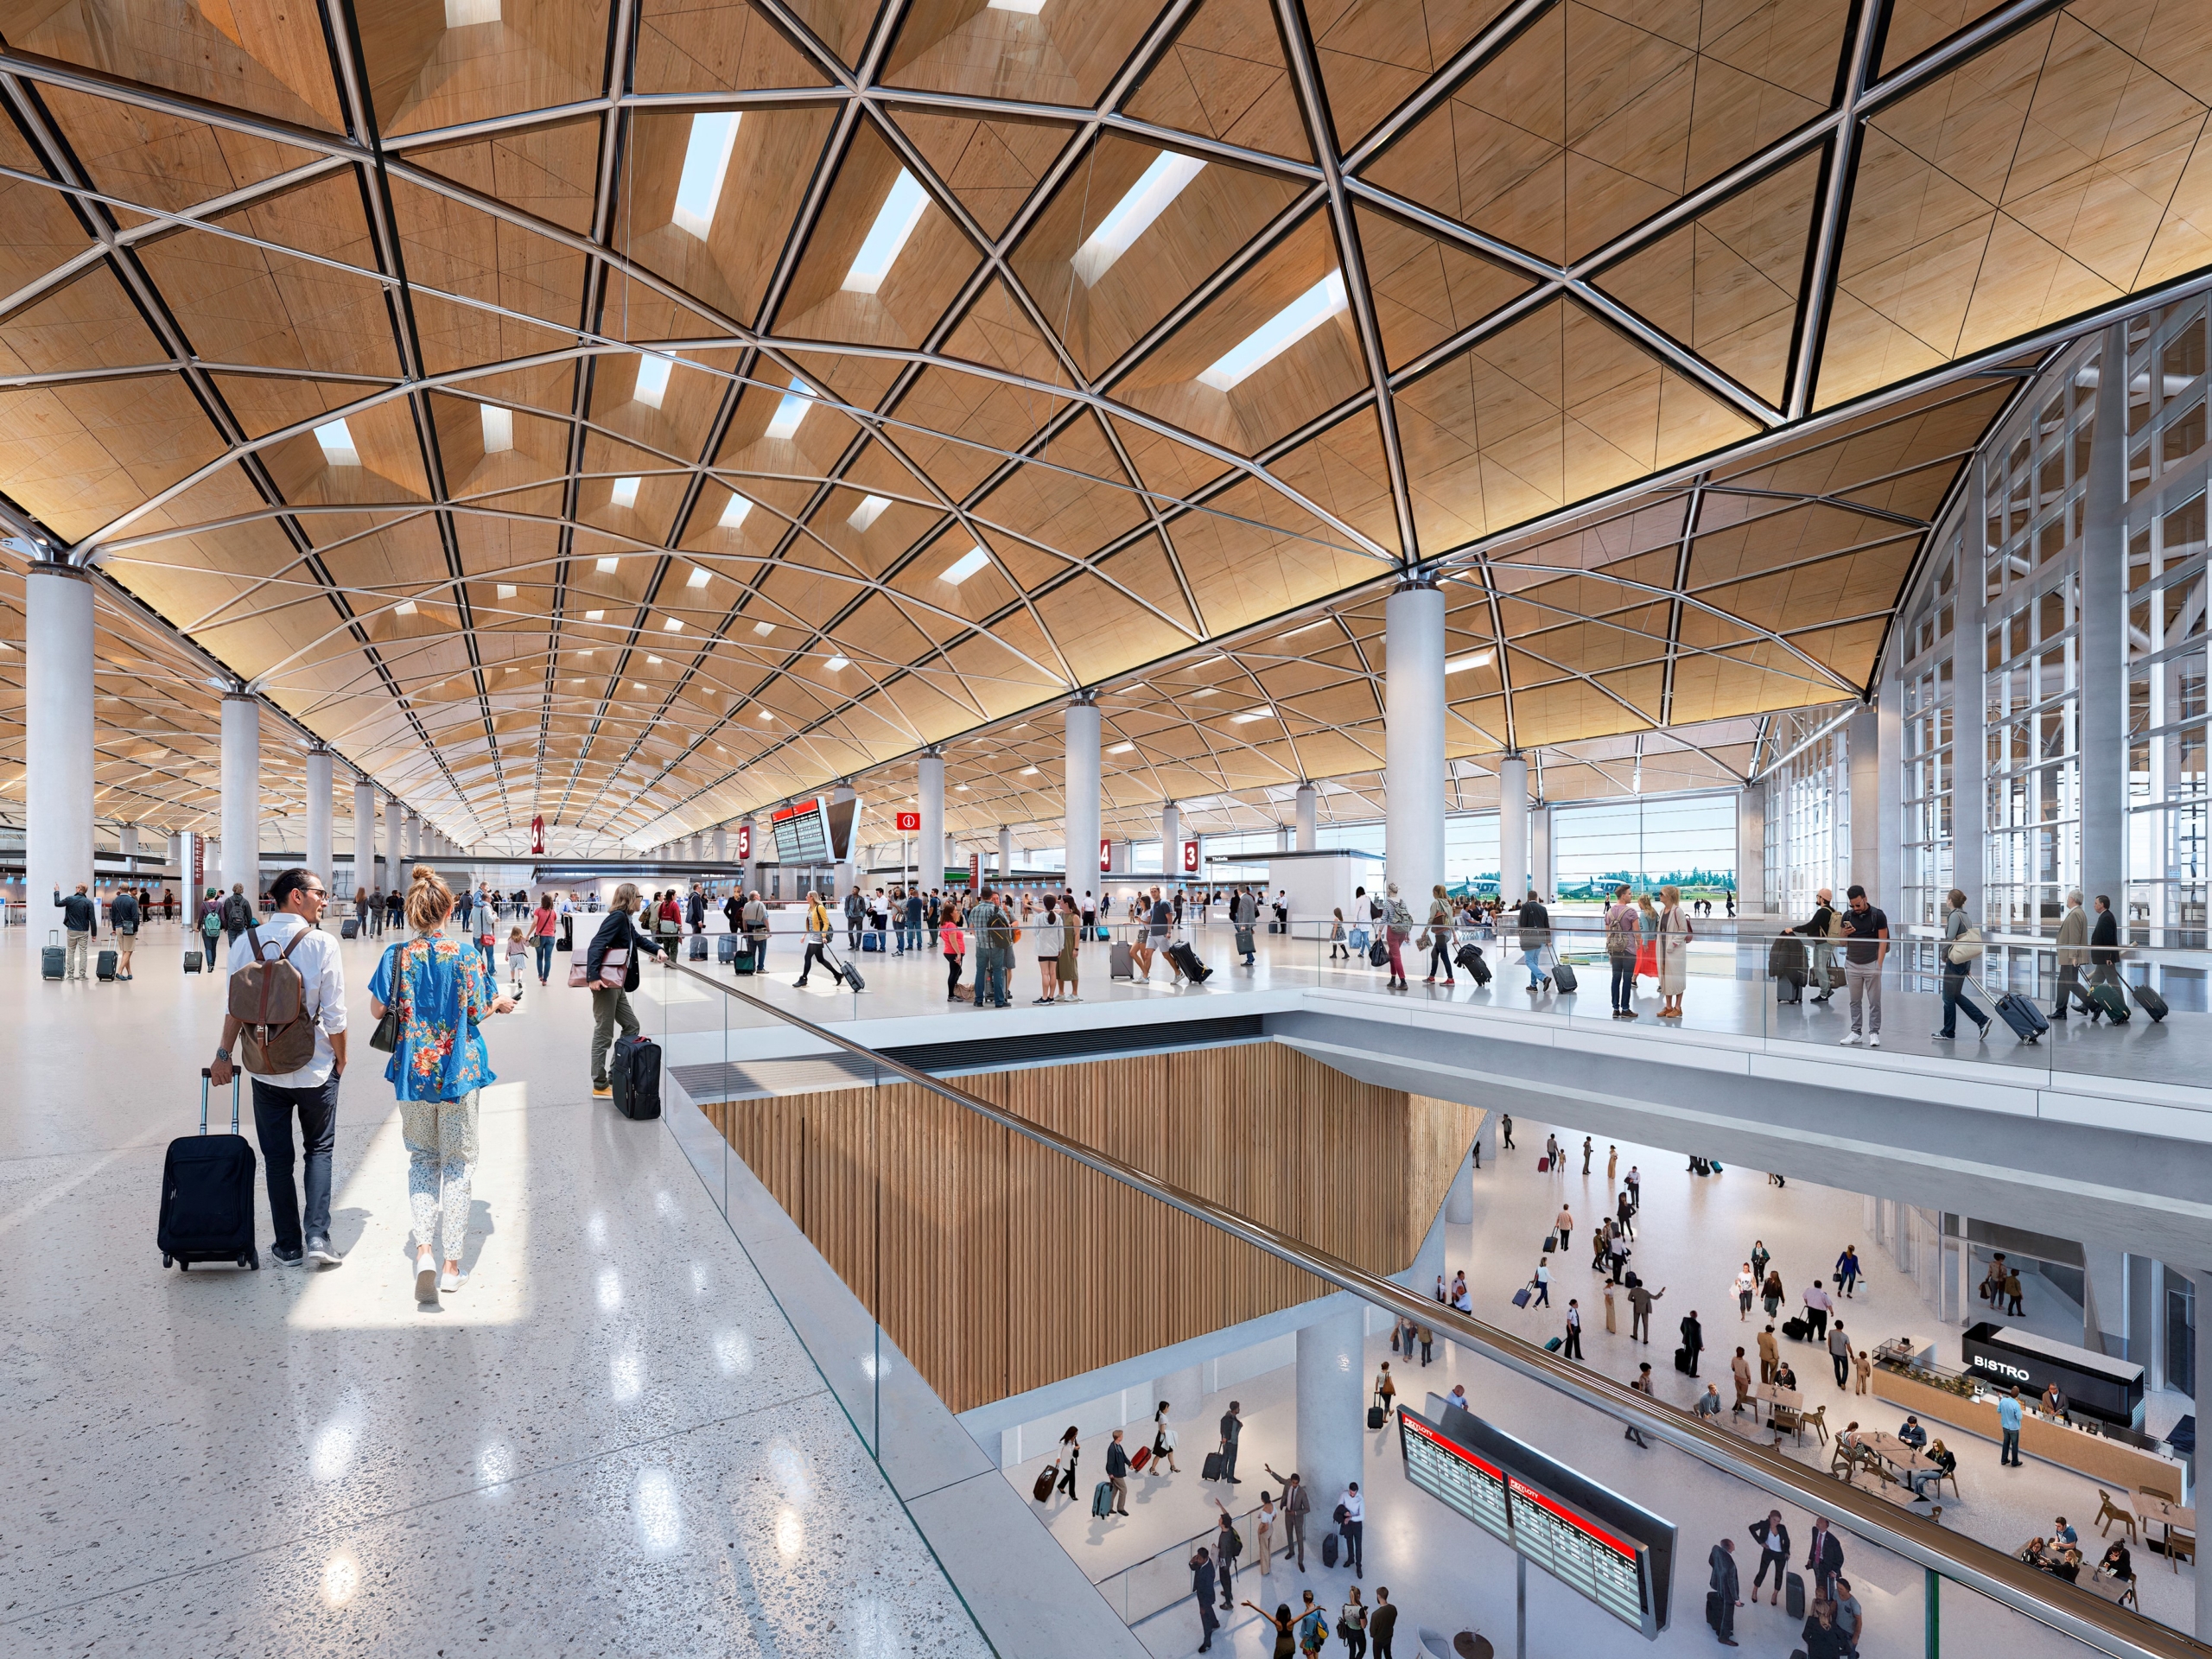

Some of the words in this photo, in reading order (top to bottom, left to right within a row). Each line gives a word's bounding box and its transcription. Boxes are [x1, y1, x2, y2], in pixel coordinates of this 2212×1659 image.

[532, 824, 538, 848] 6
[540, 824, 544, 848] 6
[740, 832, 747, 853] 5
[1101, 845, 1109, 865] 4
[1186, 847, 1196, 866] 3
[1974, 1355, 2030, 1381] BISTRO
